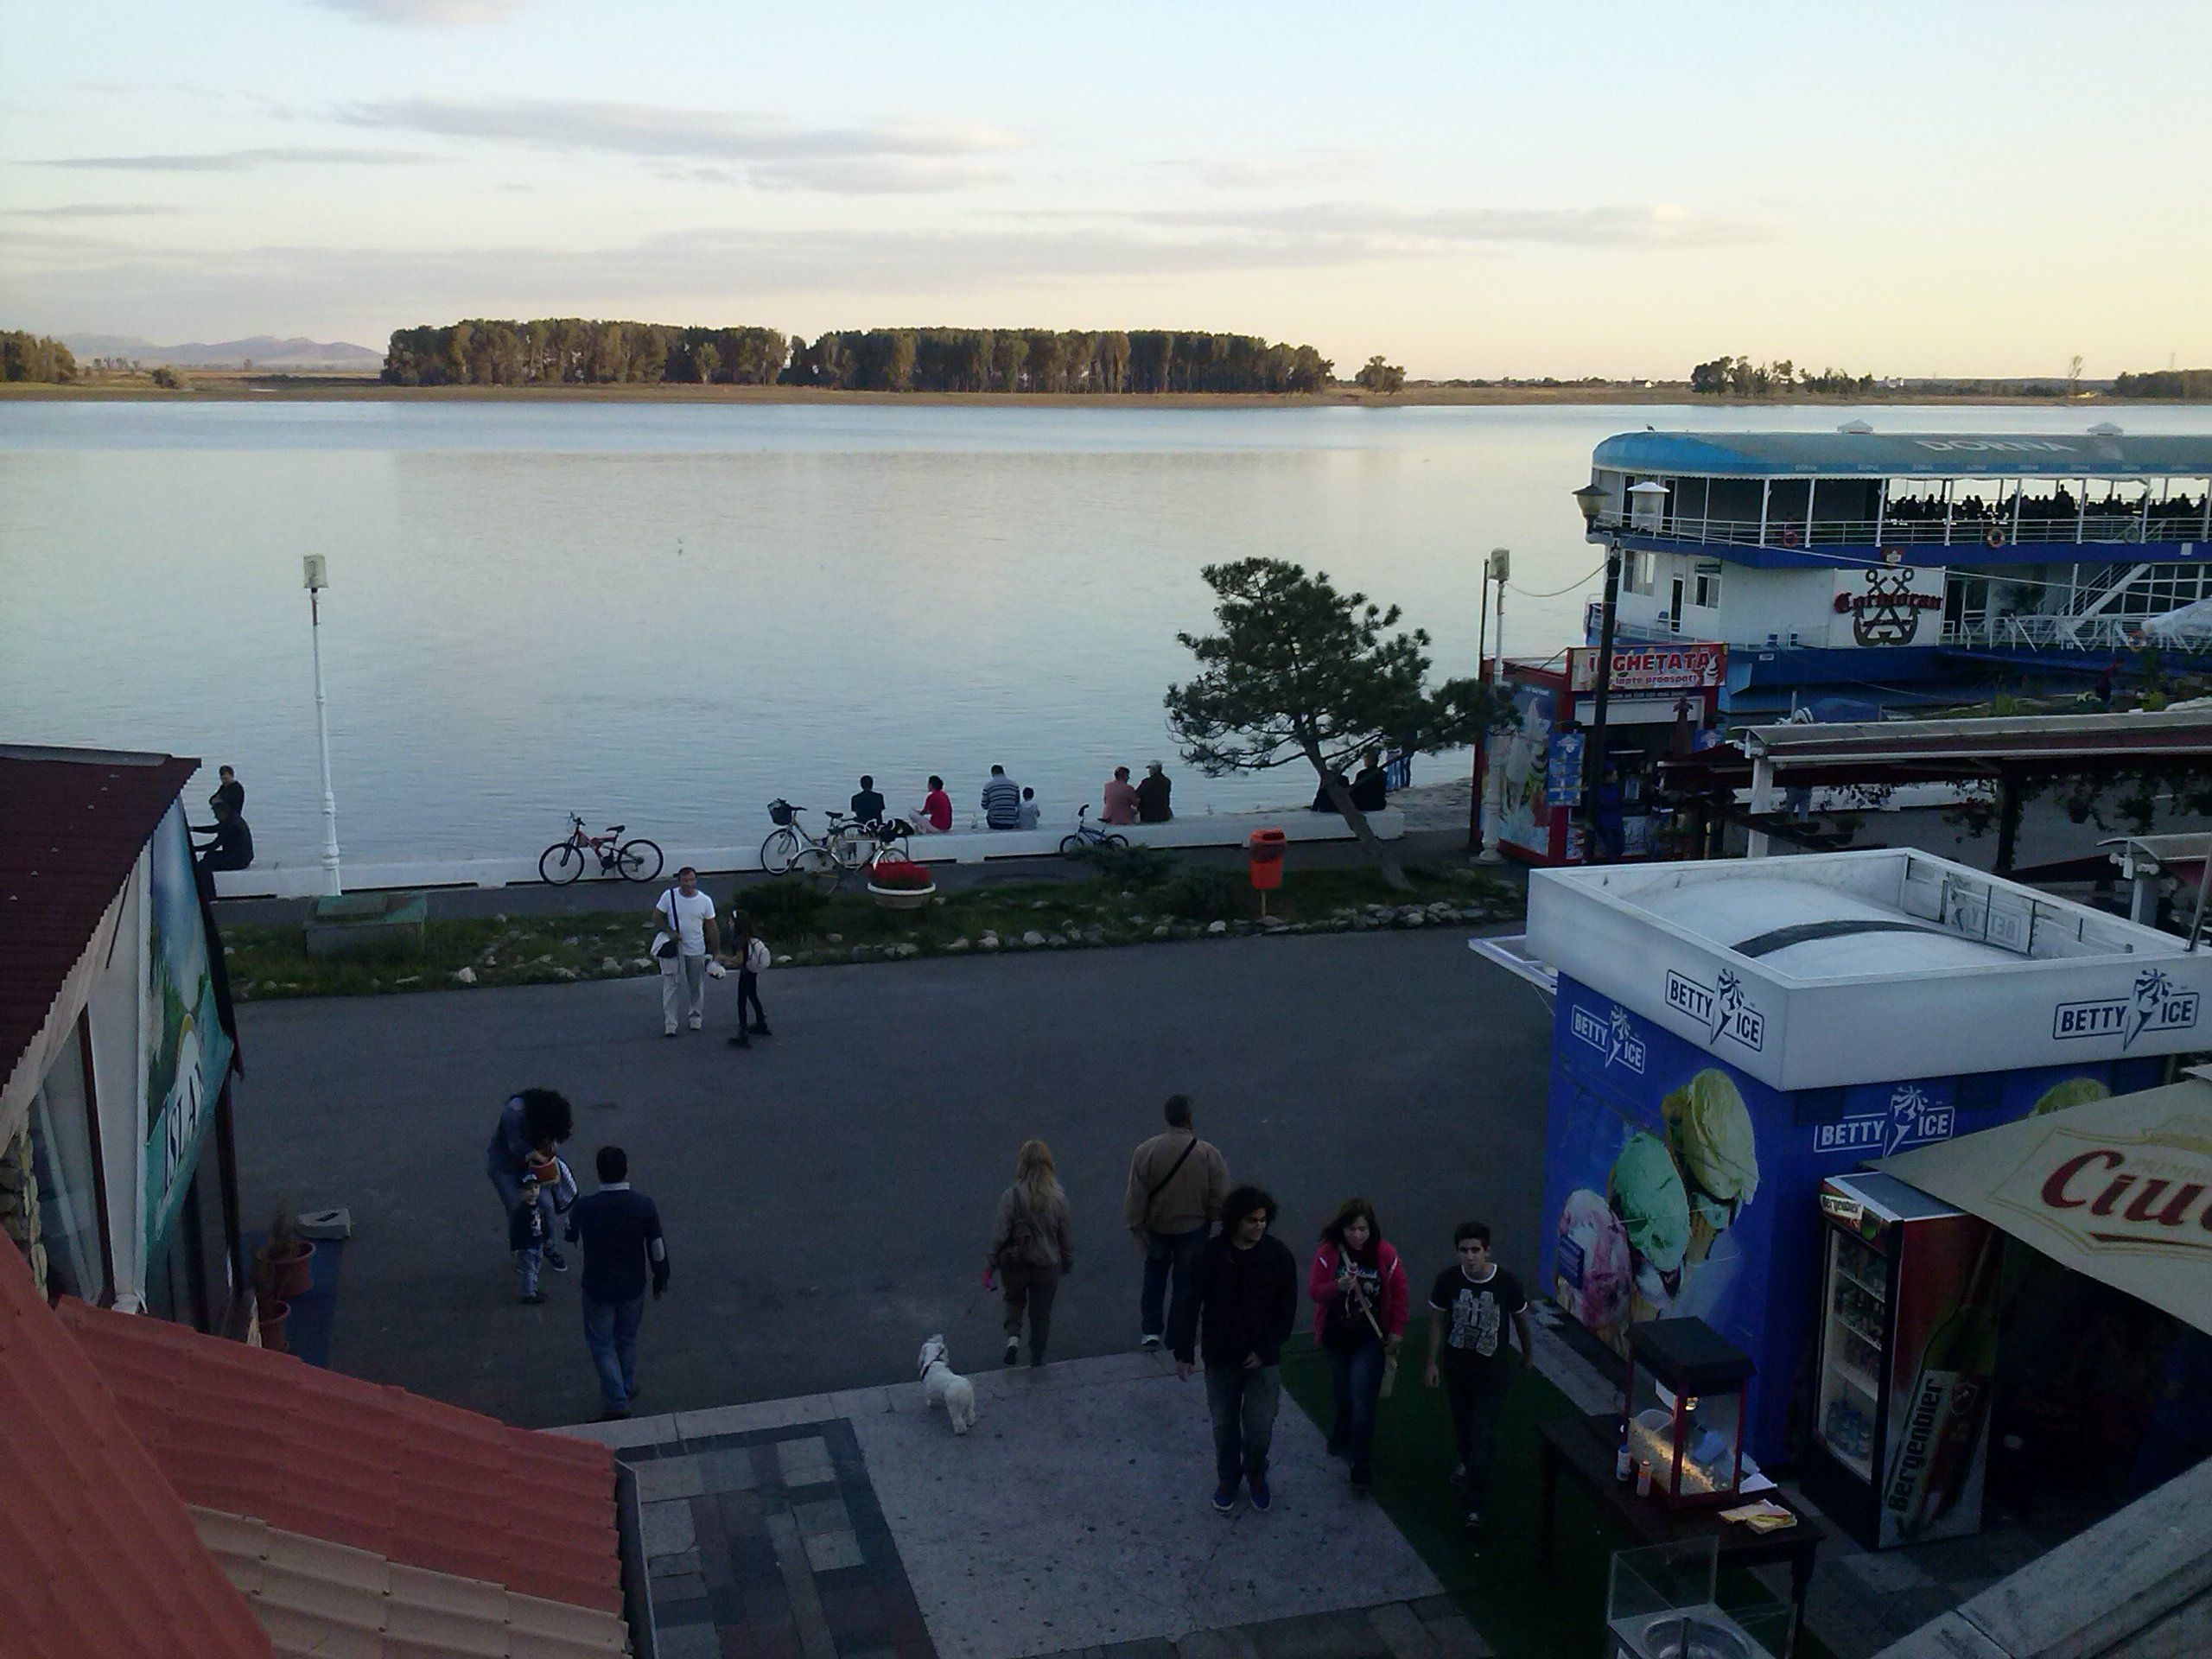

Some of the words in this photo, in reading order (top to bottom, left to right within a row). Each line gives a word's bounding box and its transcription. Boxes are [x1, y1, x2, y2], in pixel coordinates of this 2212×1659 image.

[1616, 677, 1643, 686] lapte
[1670, 979, 1713, 1017] BETTY
[1737, 1012, 1760, 1043] ICE
[2061, 1006, 2127, 1032] BETTY
[2161, 1001, 2193, 1023] ICE
[1574, 1013, 1608, 1046] BETTY
[1624, 1040, 1643, 1067] ICE
[1821, 1120, 1885, 1147] BETTY
[1917, 1114, 1949, 1137] ICE
[1887, 1378, 1943, 1511] Bergenbier
